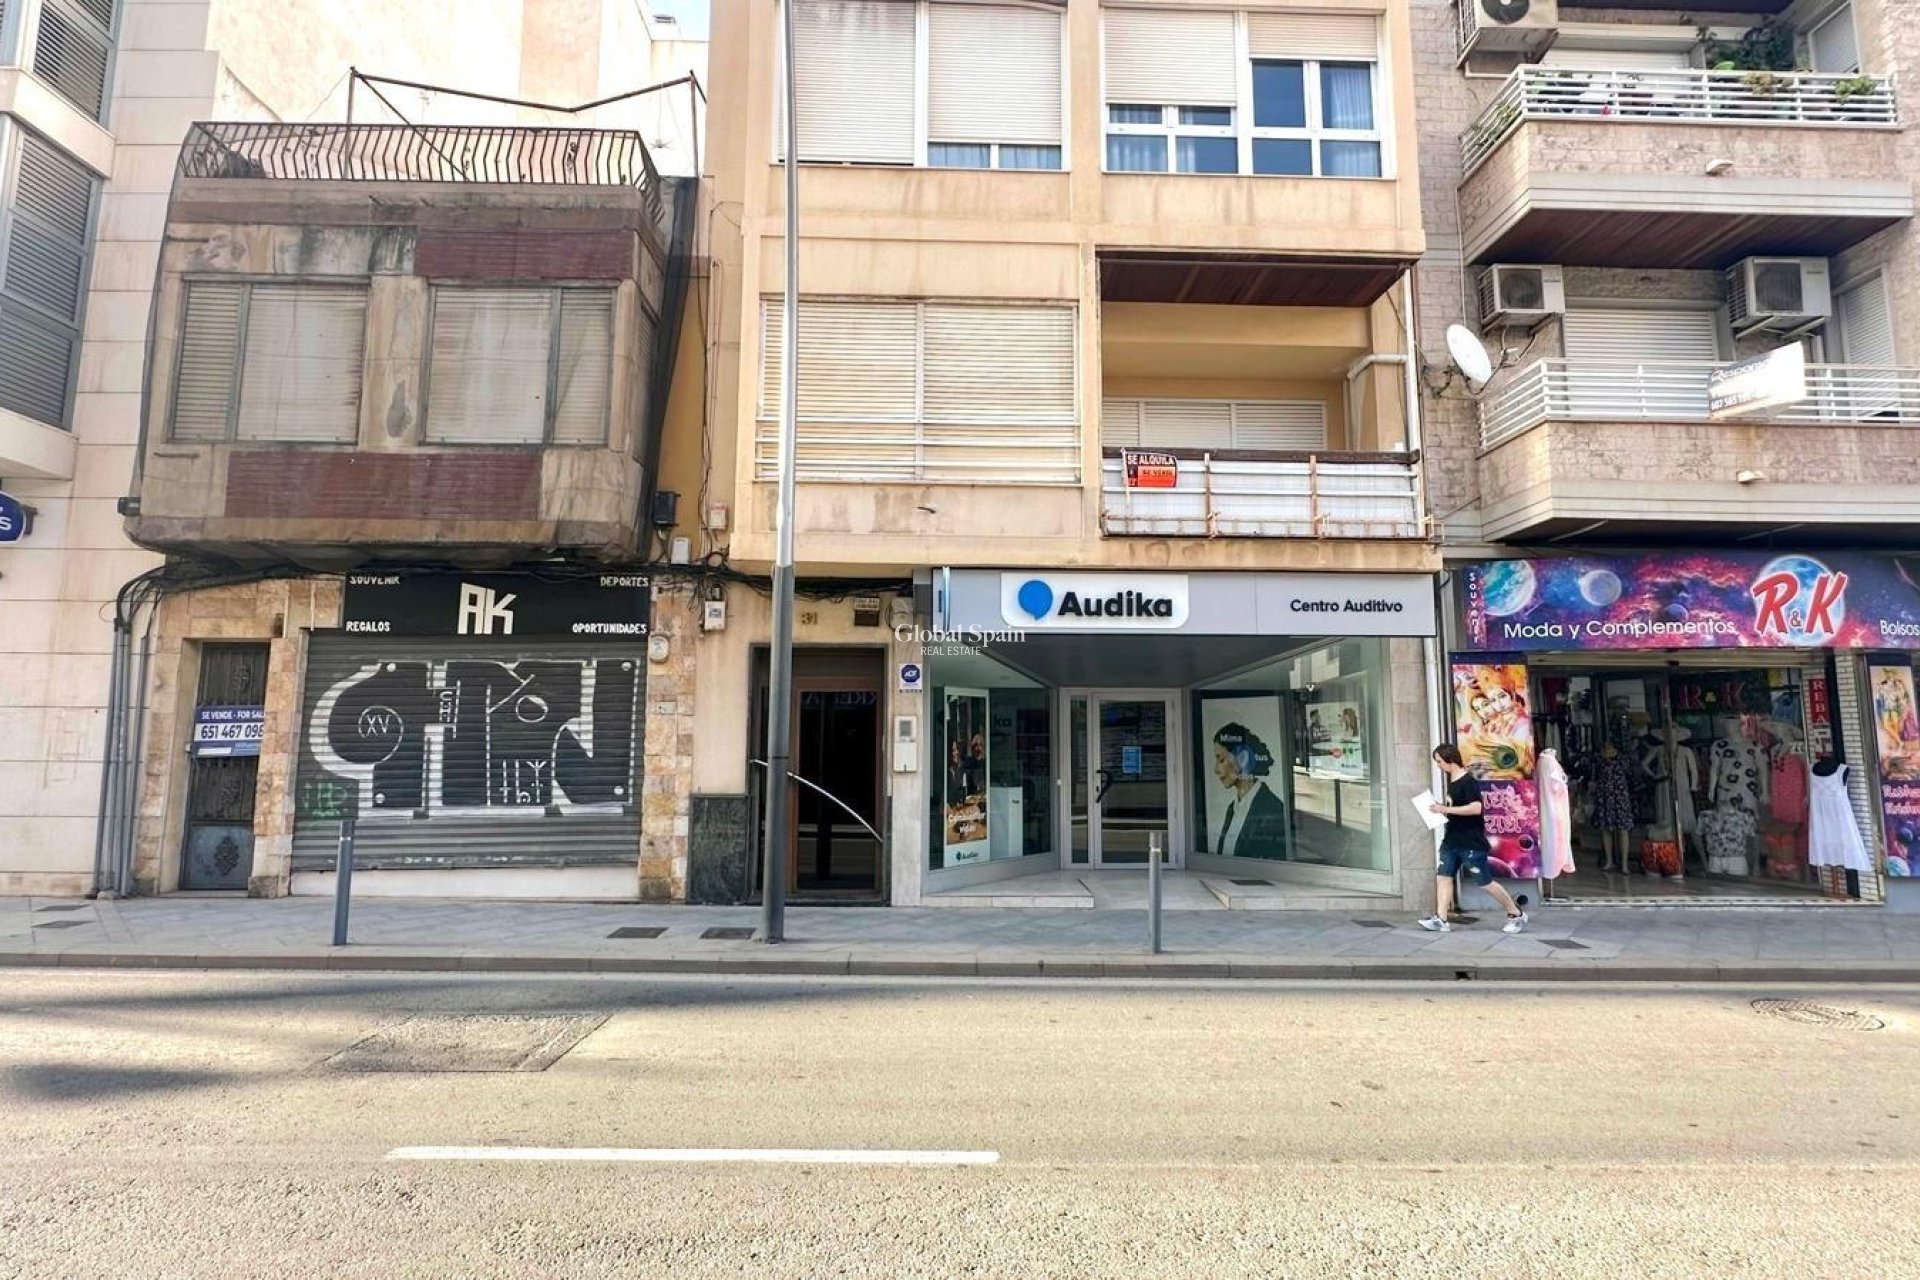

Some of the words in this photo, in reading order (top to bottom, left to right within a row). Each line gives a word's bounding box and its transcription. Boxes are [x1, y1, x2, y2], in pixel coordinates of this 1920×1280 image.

[1127, 455, 1138, 465] SE
[1139, 454, 1174, 465] ALQUILA
[600, 576, 649, 587] DEPORTES
[457, 582, 517, 635] AK
[1058, 590, 1173, 618] Audika
[1290, 598, 1340, 613] Centro
[1343, 598, 1403, 613] Auditivo
[346, 621, 391, 632] REGALOS
[572, 623, 648, 635] OPORTUNIDADES
[1504, 622, 1563, 639] Moda
[1569, 624, 1580, 640] y
[1586, 620, 1736, 637] Complementos
[1880, 620, 1919, 636] Bolsos
[202, 711, 210, 719] SE
[211, 711, 233, 719] VENDE
[237, 710, 250, 718] FOR
[201, 725, 219, 739] 651
[221, 725, 241, 738] 467
